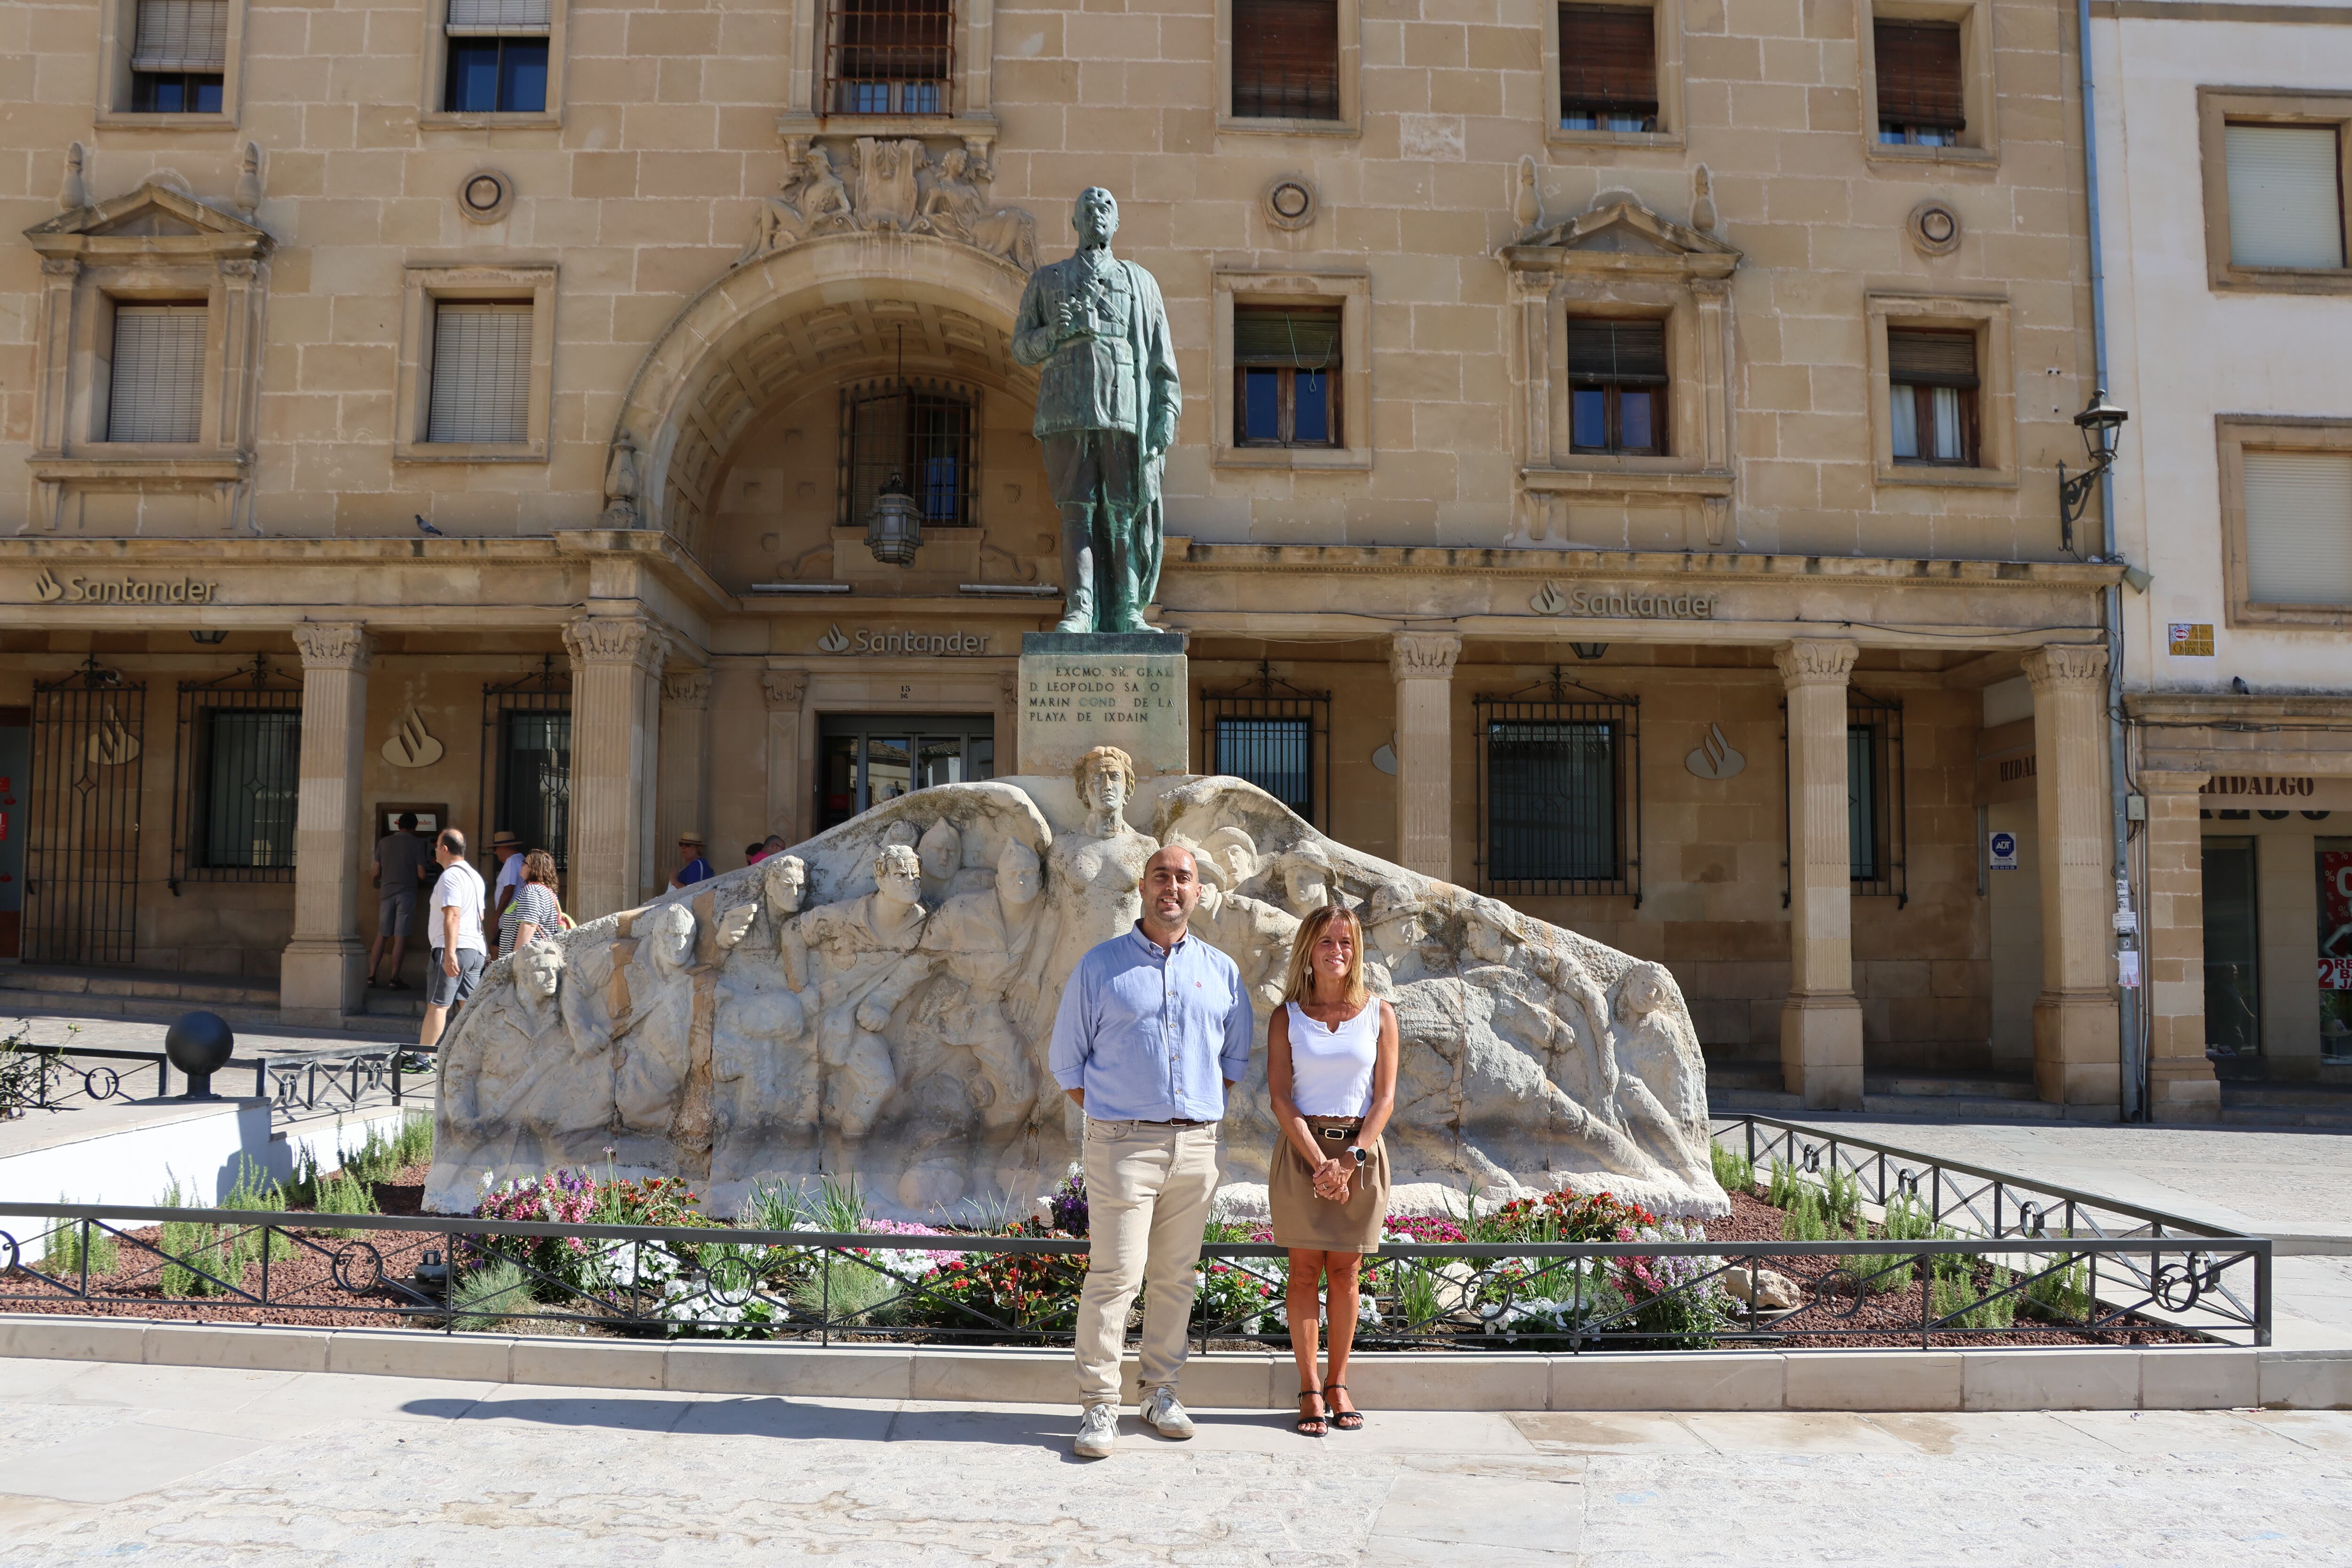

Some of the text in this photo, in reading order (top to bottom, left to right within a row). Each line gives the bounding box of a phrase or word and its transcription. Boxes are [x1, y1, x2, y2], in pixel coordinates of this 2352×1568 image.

[67, 576, 218, 601] Santander
[1572, 589, 1718, 616] Santander
[855, 629, 989, 653] Santander
[1056, 668, 1104, 677] EXCMO.
[1112, 667, 1129, 677] SR.
[1047, 683, 1114, 692] LEOPOLDO
[1030, 698, 1070, 707] MARIN
[1134, 698, 1149, 707] DE
[1159, 698, 1174, 707] LA
[1030, 712, 1148, 722] PLAYA DE IXDAIN
[1996, 841, 2011, 850] ADT
